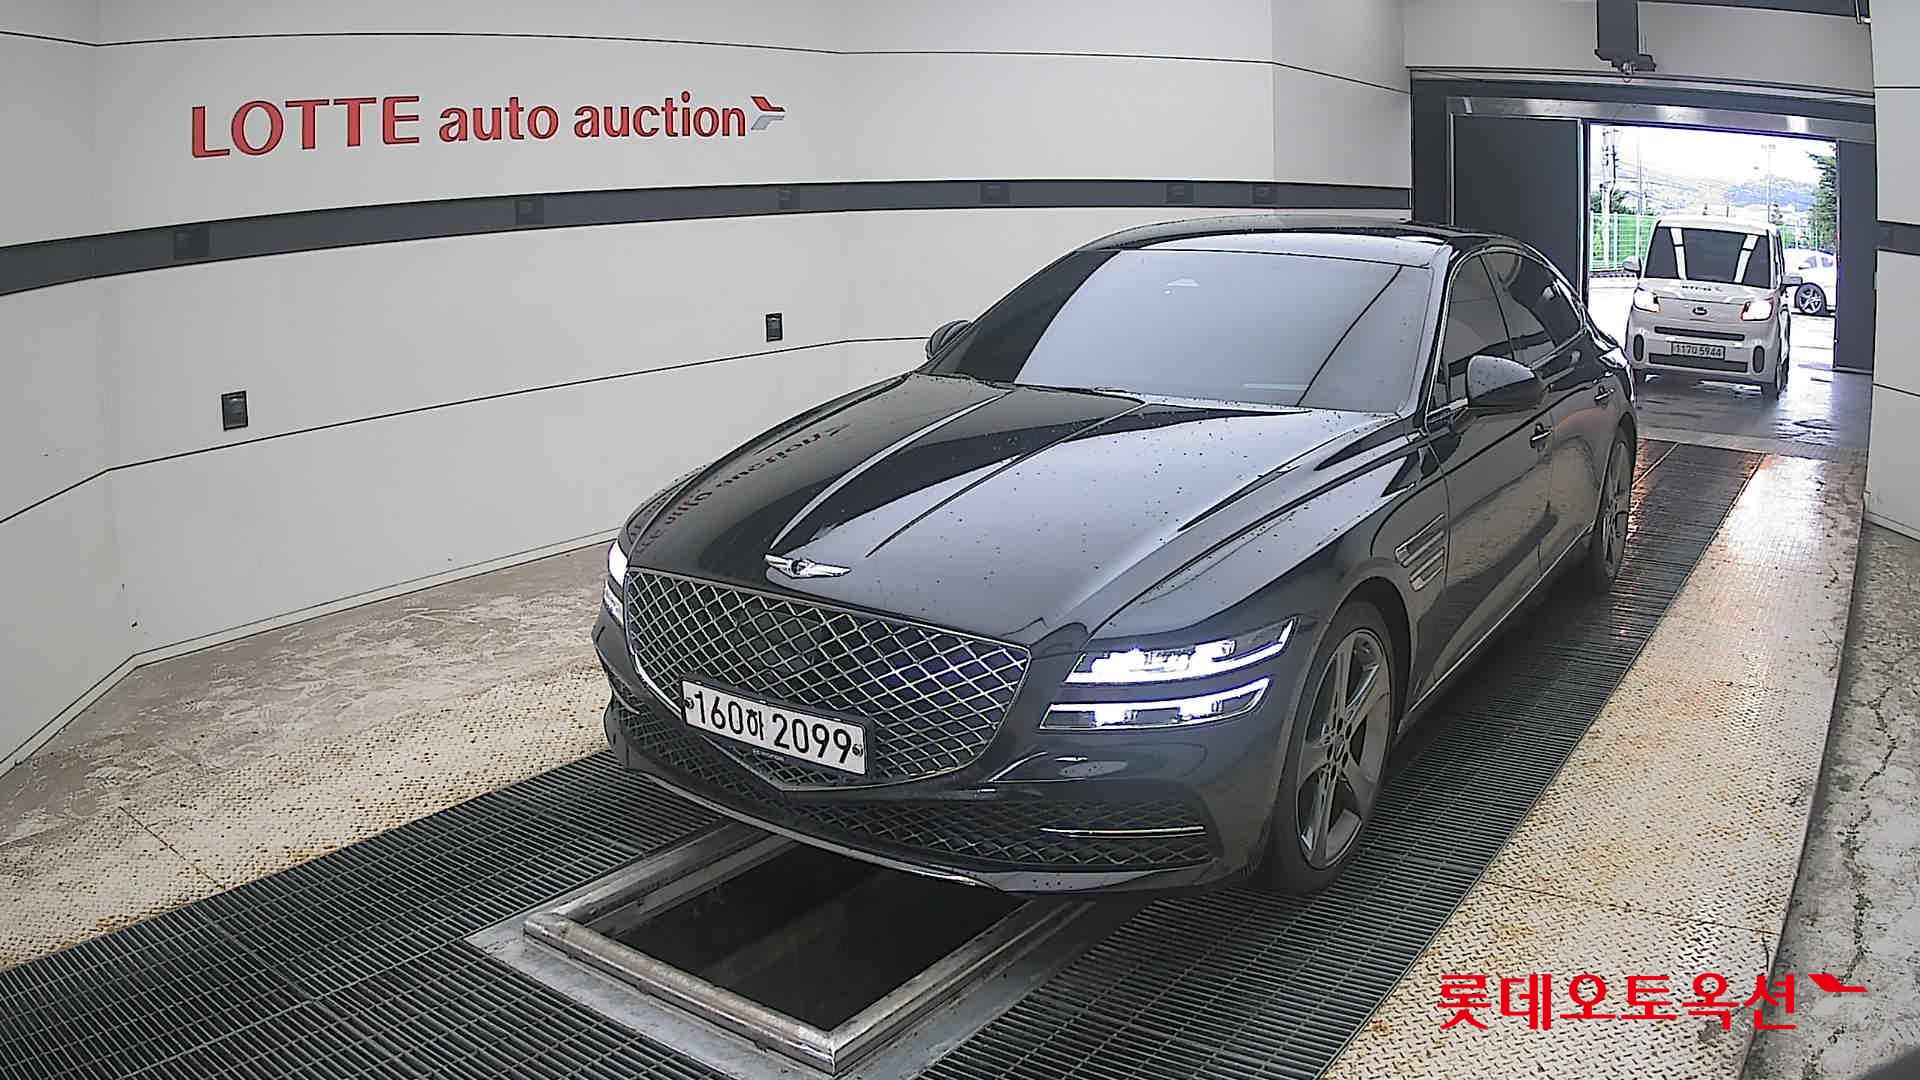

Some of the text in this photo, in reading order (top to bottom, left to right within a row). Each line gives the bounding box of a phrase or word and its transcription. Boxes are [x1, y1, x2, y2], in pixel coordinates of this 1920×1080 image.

[192, 90, 748, 158] LOTTE auto auction
[693, 691, 852, 764] 160하 2099
